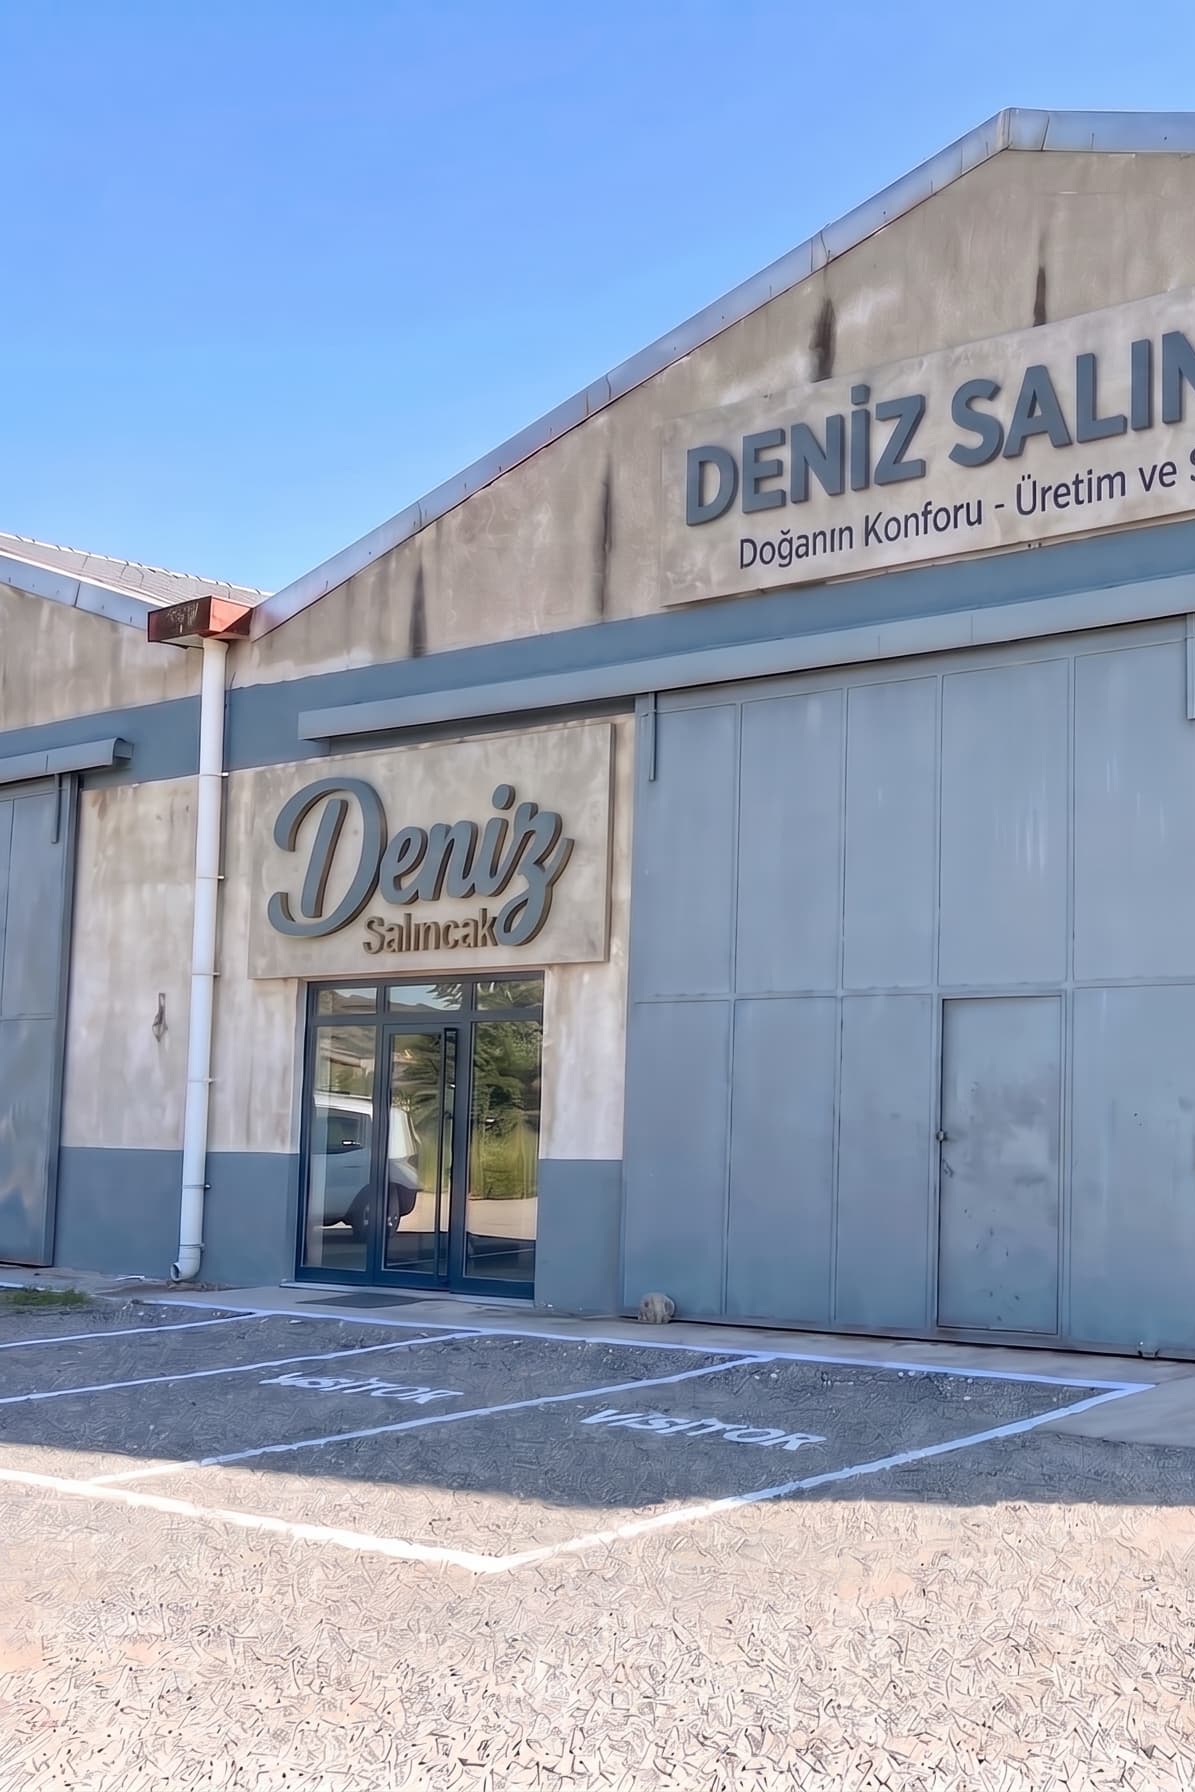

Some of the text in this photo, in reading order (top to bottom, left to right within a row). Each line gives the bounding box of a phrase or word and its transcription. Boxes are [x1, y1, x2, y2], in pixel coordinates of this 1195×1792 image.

[685, 383, 927, 527] DENİZ
[738, 523, 855, 571] Doğanın
[863, 499, 984, 546] Konforu
[1015, 468, 1127, 519] Üretim
[1137, 461, 1178, 489] ve
[267, 777, 575, 947] Deniz
[363, 909, 500, 955] Salıncak
[580, 1409, 827, 1451] VISITOR
